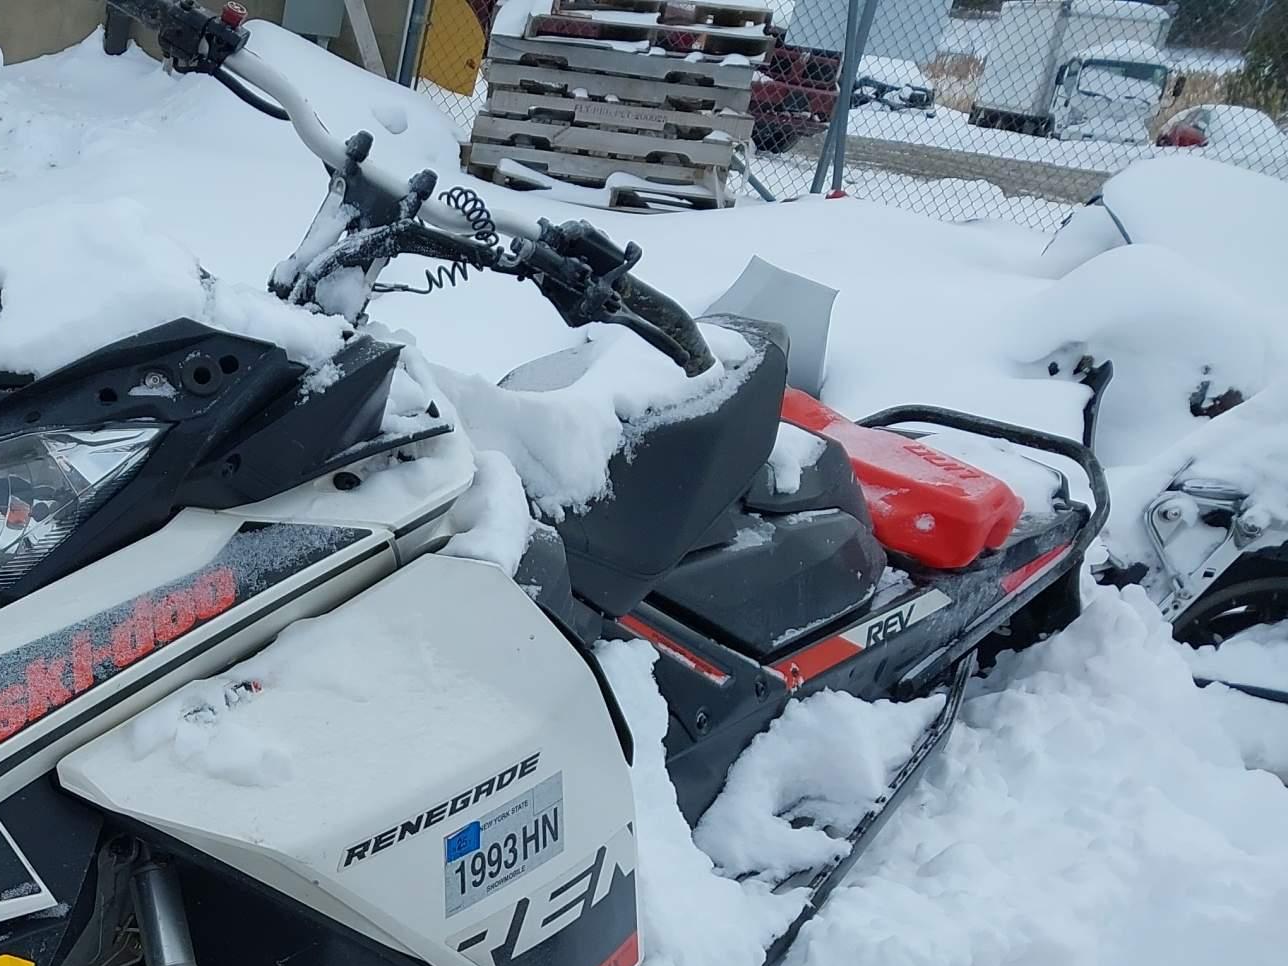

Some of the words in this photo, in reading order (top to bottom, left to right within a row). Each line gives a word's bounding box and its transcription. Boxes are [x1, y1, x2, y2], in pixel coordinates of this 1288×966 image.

[866, 604, 915, 648] REV
[343, 751, 541, 868] RENEGADE
[480, 819, 494, 832] NEW
[494, 810, 510, 824] YORK
[511, 799, 529, 814] STATE
[486, 864, 527, 893] SNOWMOBILE
